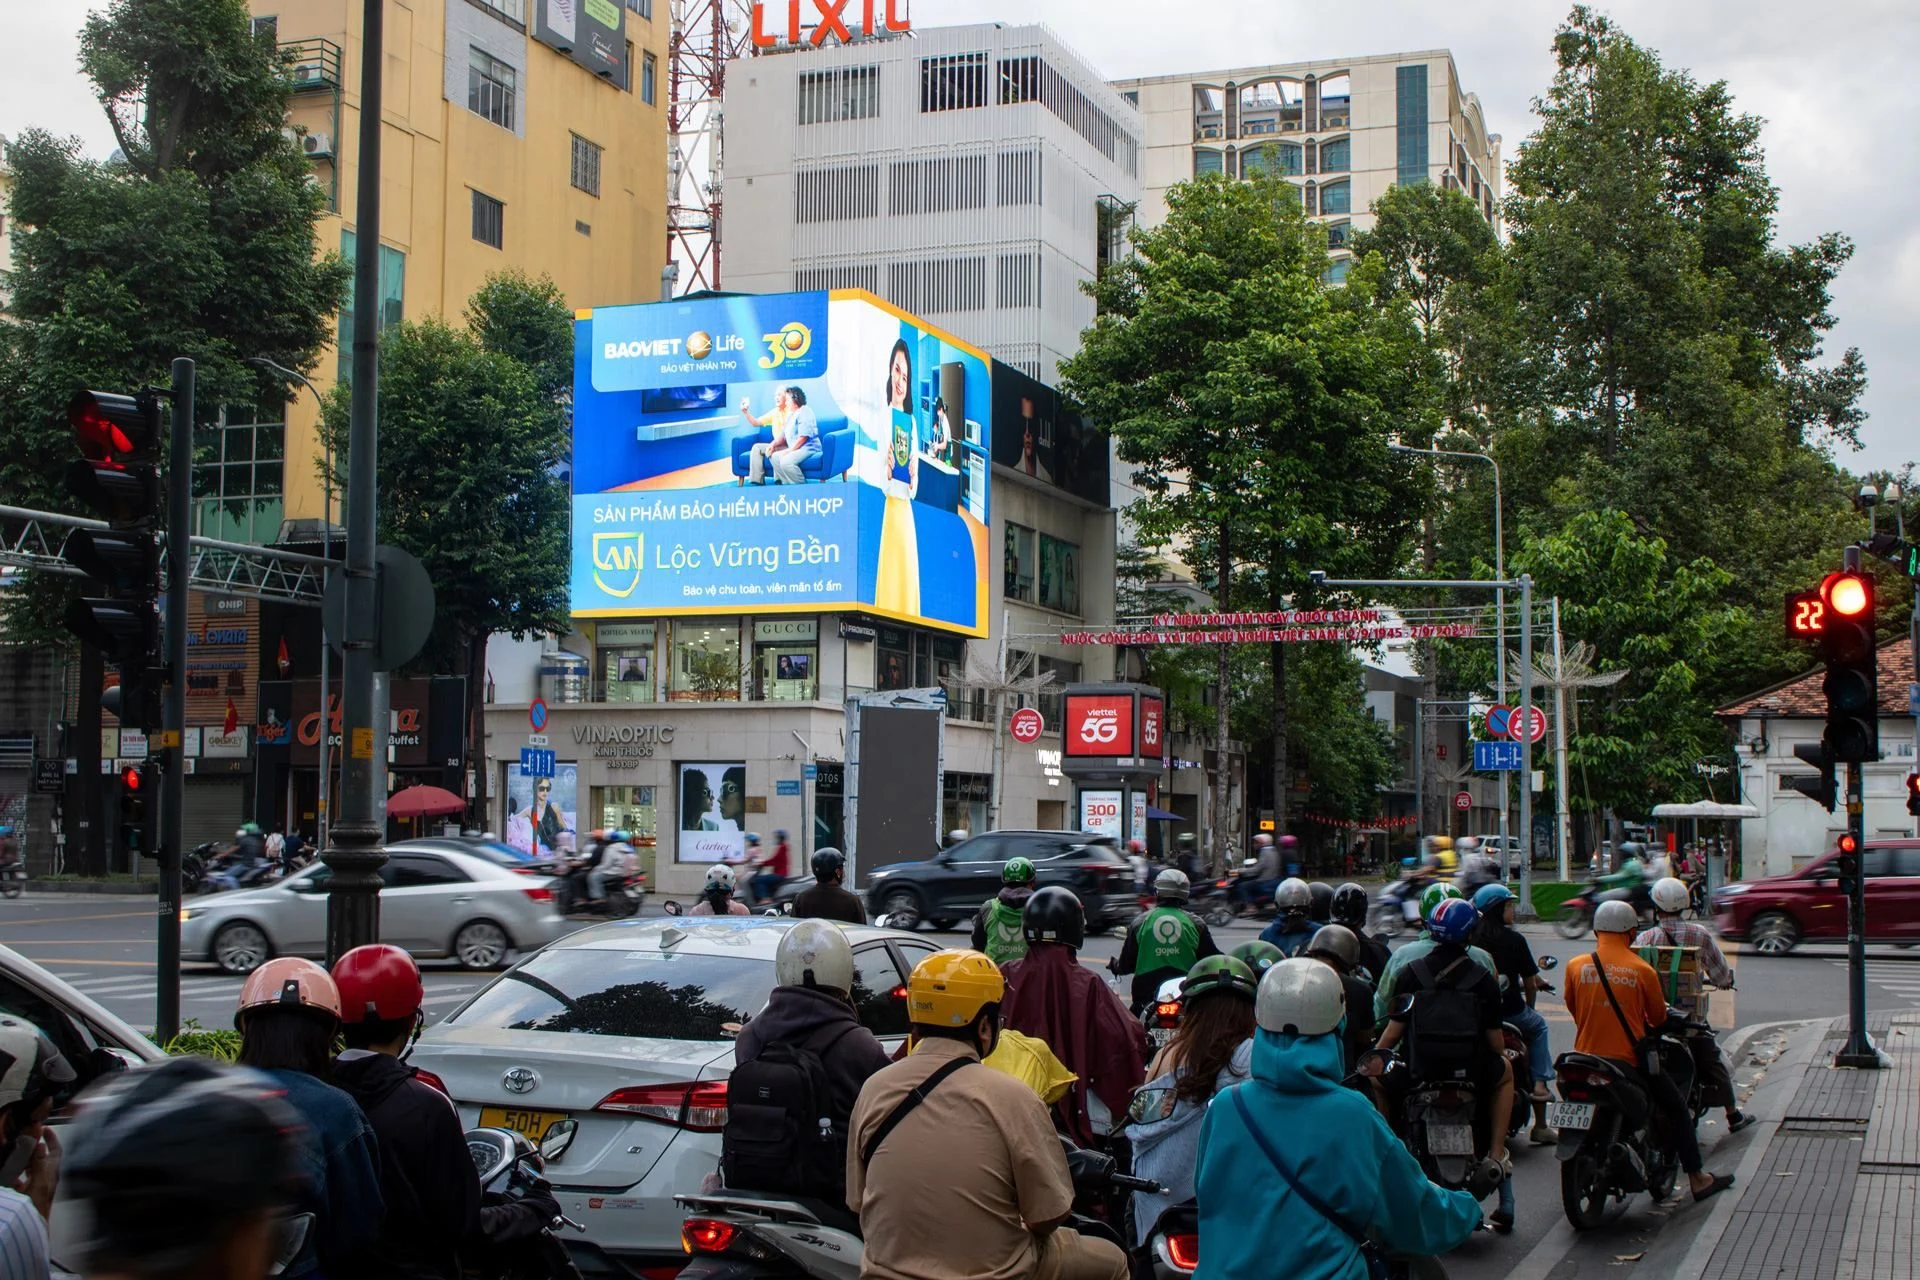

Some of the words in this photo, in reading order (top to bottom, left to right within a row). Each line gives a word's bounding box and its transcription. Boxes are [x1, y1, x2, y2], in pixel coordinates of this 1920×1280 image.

[751, 0, 911, 48] LIXIL
[604, 338, 682, 359] BAOVIET
[716, 335, 745, 352] Life
[696, 360, 718, 372] NHÂN
[593, 503, 626, 523] SẢN
[630, 500, 676, 521] PHẨM
[680, 499, 715, 519] BẢO
[718, 496, 760, 518] HIỂM
[763, 494, 801, 516] HỖN
[805, 497, 843, 517] HỢP
[656, 544, 701, 574] Lộc
[709, 541, 779, 573] Vững
[788, 534, 840, 565] Bền
[704, 584, 717, 597] vệ
[719, 584, 737, 595] chu
[739, 583, 764, 595] toàn,
[766, 582, 787, 593] viên
[789, 583, 812, 593] mãn
[1174, 609, 1203, 627] NIỆM
[1206, 613, 1221, 625] 80
[1225, 609, 1253, 625] NĂM
[1256, 607, 1289, 624] NGÀY
[1293, 607, 1328, 624] QUỐC
[1332, 608, 1378, 623] KHÁNH
[1795, 601, 1824, 631] 22
[600, 627, 628, 636] BOTTEGA
[762, 623, 812, 634] GUCCI
[1061, 630, 1095, 646] NƯỚC
[1100, 629, 1133, 646] CỘNG
[1184, 629, 1206, 644] HỘI
[1237, 627, 1276, 642] NGHĨA
[1279, 627, 1305, 643] VIỆT
[1309, 628, 1338, 641] NAM
[1087, 708, 1118, 716] viettel
[573, 725, 674, 745] VINAOPTIC
[1015, 721, 1038, 737] 5G
[1080, 717, 1118, 743] 5G
[1144, 719, 1157, 744] 5G
[388, 734, 420, 747] Buffet
[447, 758, 459, 767] 243
[818, 773, 839, 784] OTOS
[1087, 804, 1116, 816] 300
[1087, 818, 1102, 826] GB
[695, 839, 732, 851] Cartier
[999, 943, 1024, 953] gojek
[1155, 946, 1180, 957] gojek
[1606, 963, 1639, 977] Shopee
[1606, 973, 1638, 988] Food
[505, 1111, 542, 1133] 50H
[1553, 1115, 1590, 1129] 969.10
